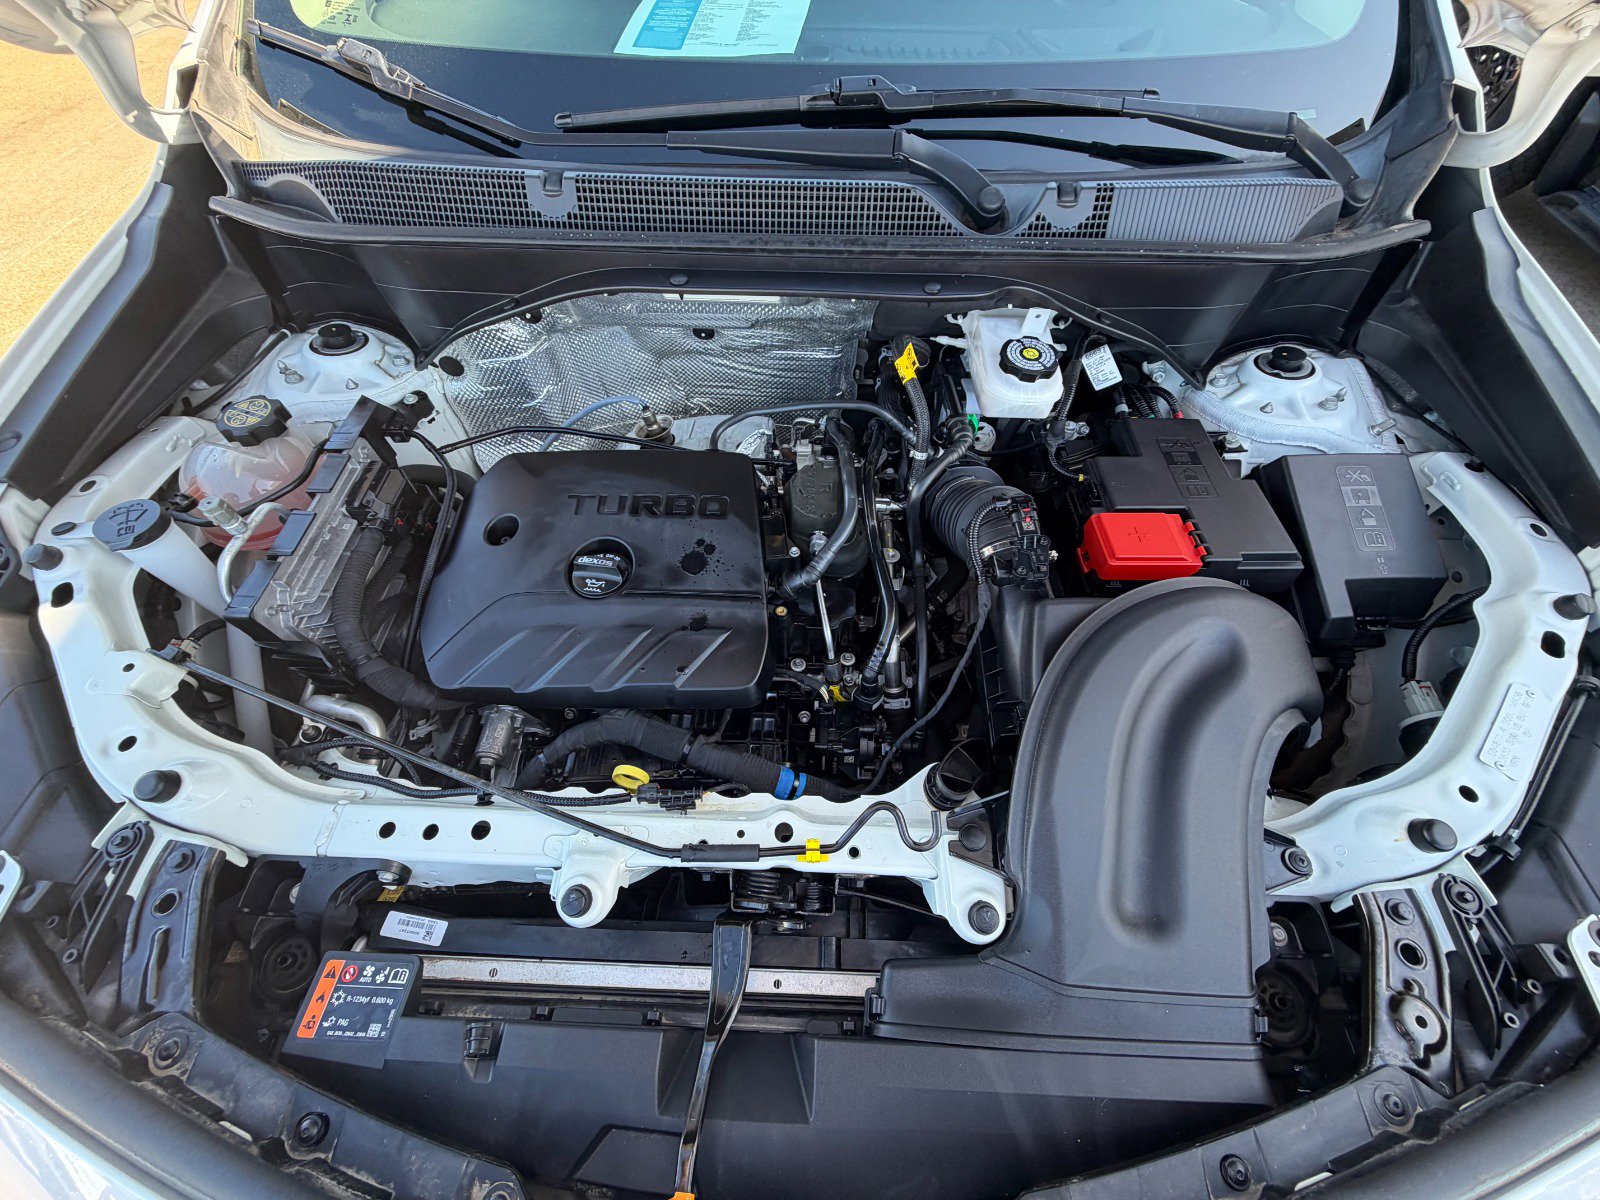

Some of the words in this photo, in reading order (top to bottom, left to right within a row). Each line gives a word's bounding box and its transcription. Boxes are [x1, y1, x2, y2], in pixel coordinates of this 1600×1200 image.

[568, 493, 730, 518] TURBO
[577, 556, 613, 567] dexos
[346, 996, 370, 1004] R-1234yf
[386, 997, 394, 1005] kg
[337, 1018, 349, 1027] PAG
